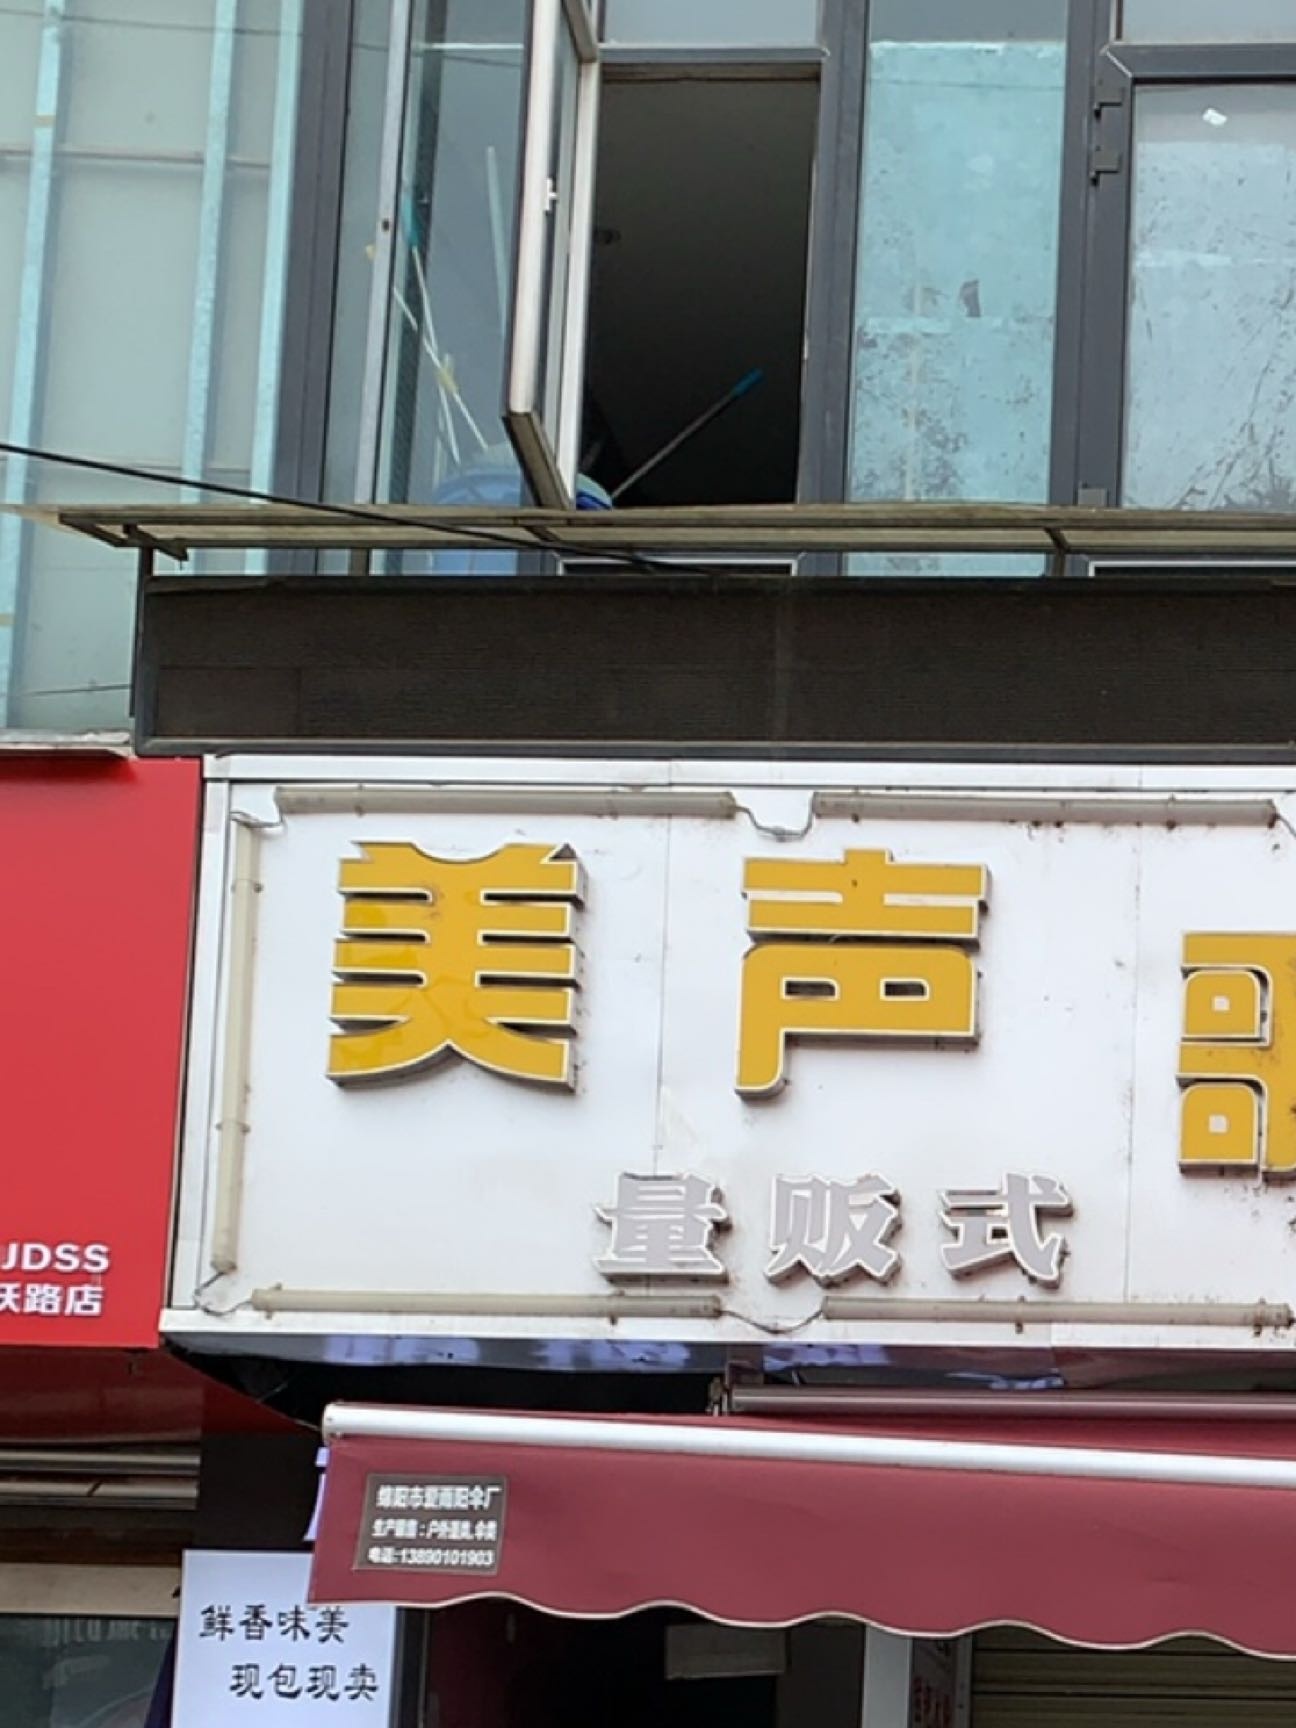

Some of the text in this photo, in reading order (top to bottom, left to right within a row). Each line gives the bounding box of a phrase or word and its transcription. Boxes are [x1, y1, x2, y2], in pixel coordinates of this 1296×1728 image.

[593, 1172, 1074, 1290] 量贩式
[198, 1603, 350, 1644] 鲜香味美
[228, 1661, 380, 1702] 现包现卖
